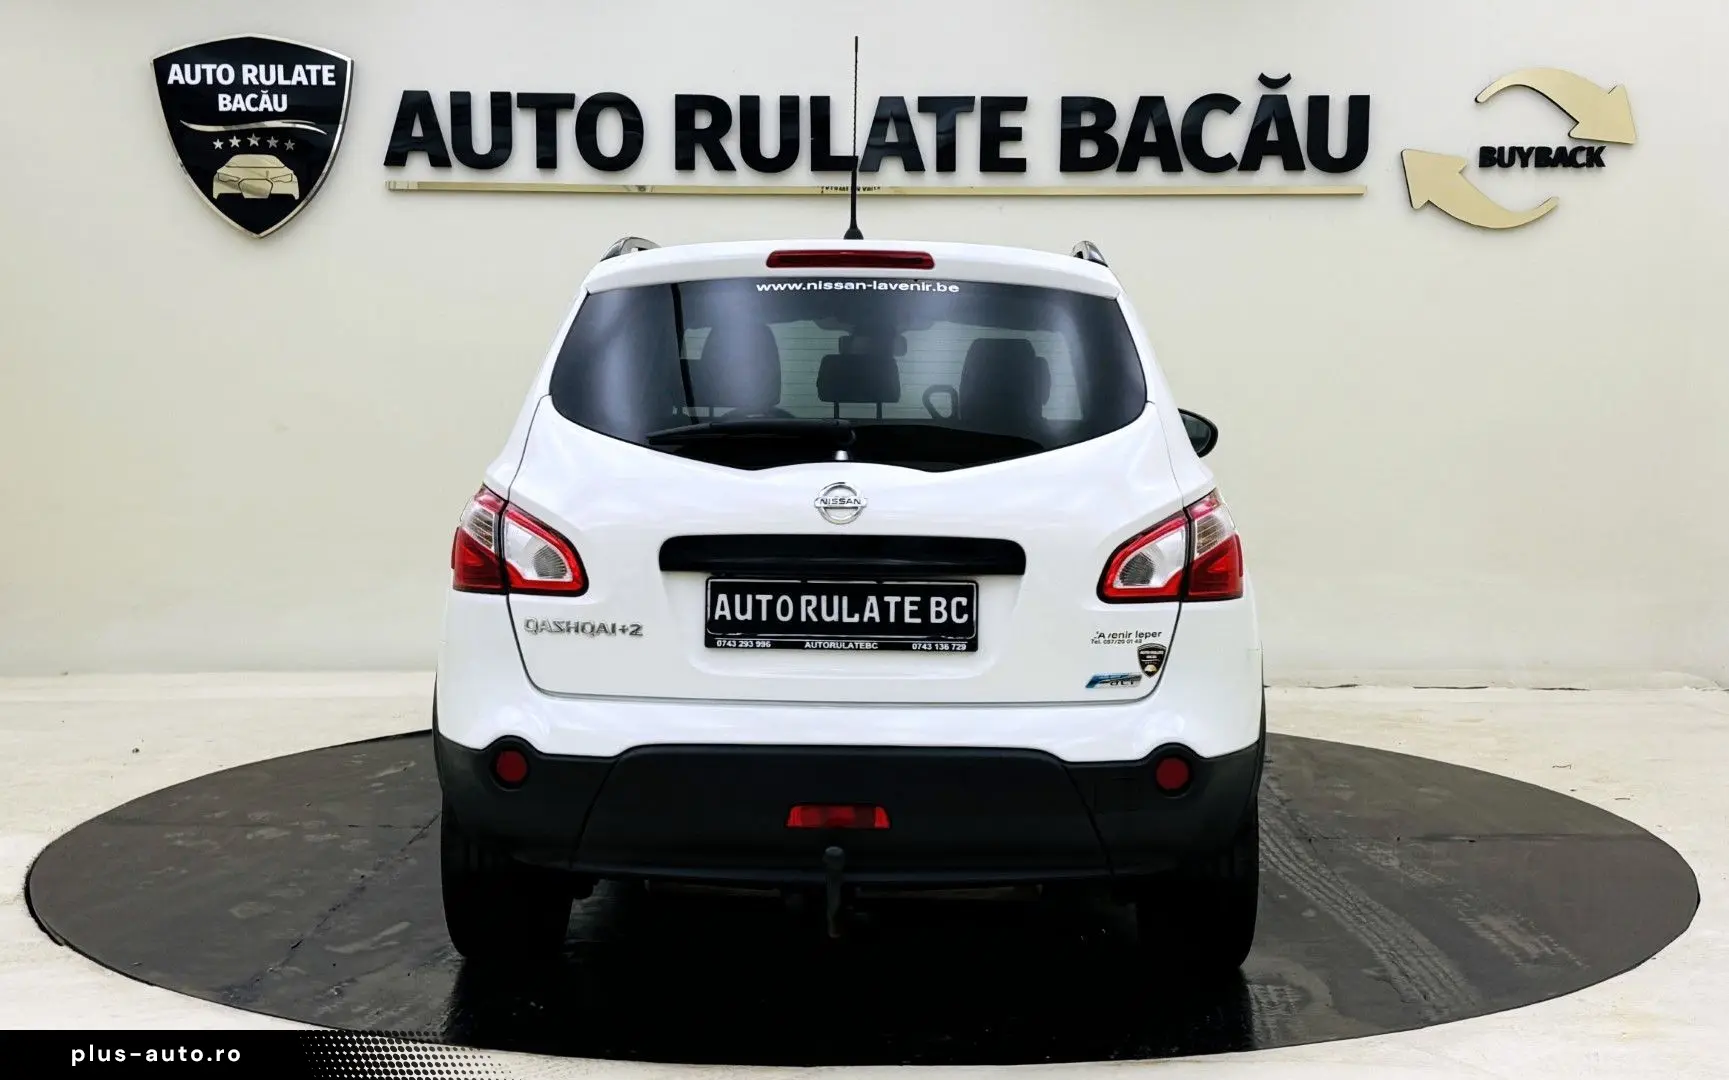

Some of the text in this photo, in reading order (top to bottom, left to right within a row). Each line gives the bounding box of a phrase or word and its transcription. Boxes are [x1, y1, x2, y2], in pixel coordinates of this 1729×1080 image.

[167, 63, 336, 86] AUTO RULATE
[217, 90, 288, 112] BACĂU
[383, 72, 1370, 174] AUTO RULATE BACĂU
[1478, 146, 1607, 168] BUYBACK
[756, 280, 960, 293] www.nissan-lavenir.be
[714, 593, 969, 625] AUTO RULATE BC
[524, 618, 643, 637] QASHQAI+2
[716, 639, 736, 648] 0743
[804, 641, 879, 650] AUTORULATEBC
[912, 642, 933, 651] 0743
[951, 643, 967, 651] 729
